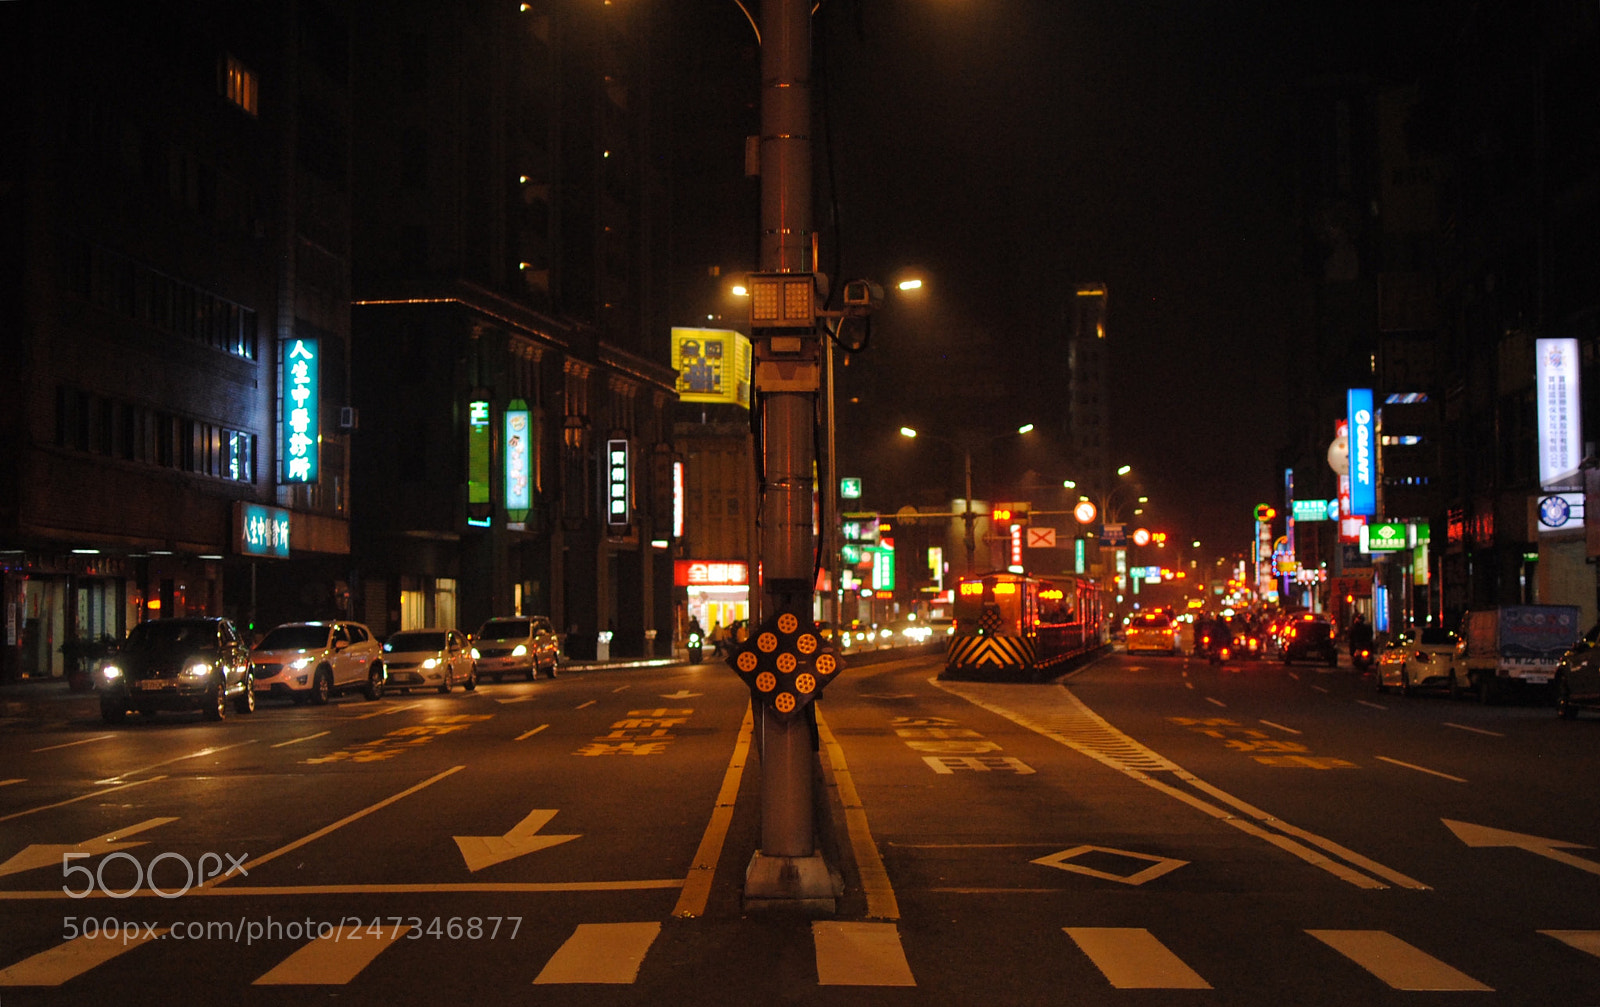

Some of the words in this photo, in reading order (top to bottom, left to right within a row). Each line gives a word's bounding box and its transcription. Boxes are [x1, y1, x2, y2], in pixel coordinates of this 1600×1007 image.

[289, 339, 313, 482] 人生中醫診所
[242, 515, 289, 549] 人生中醫診所
